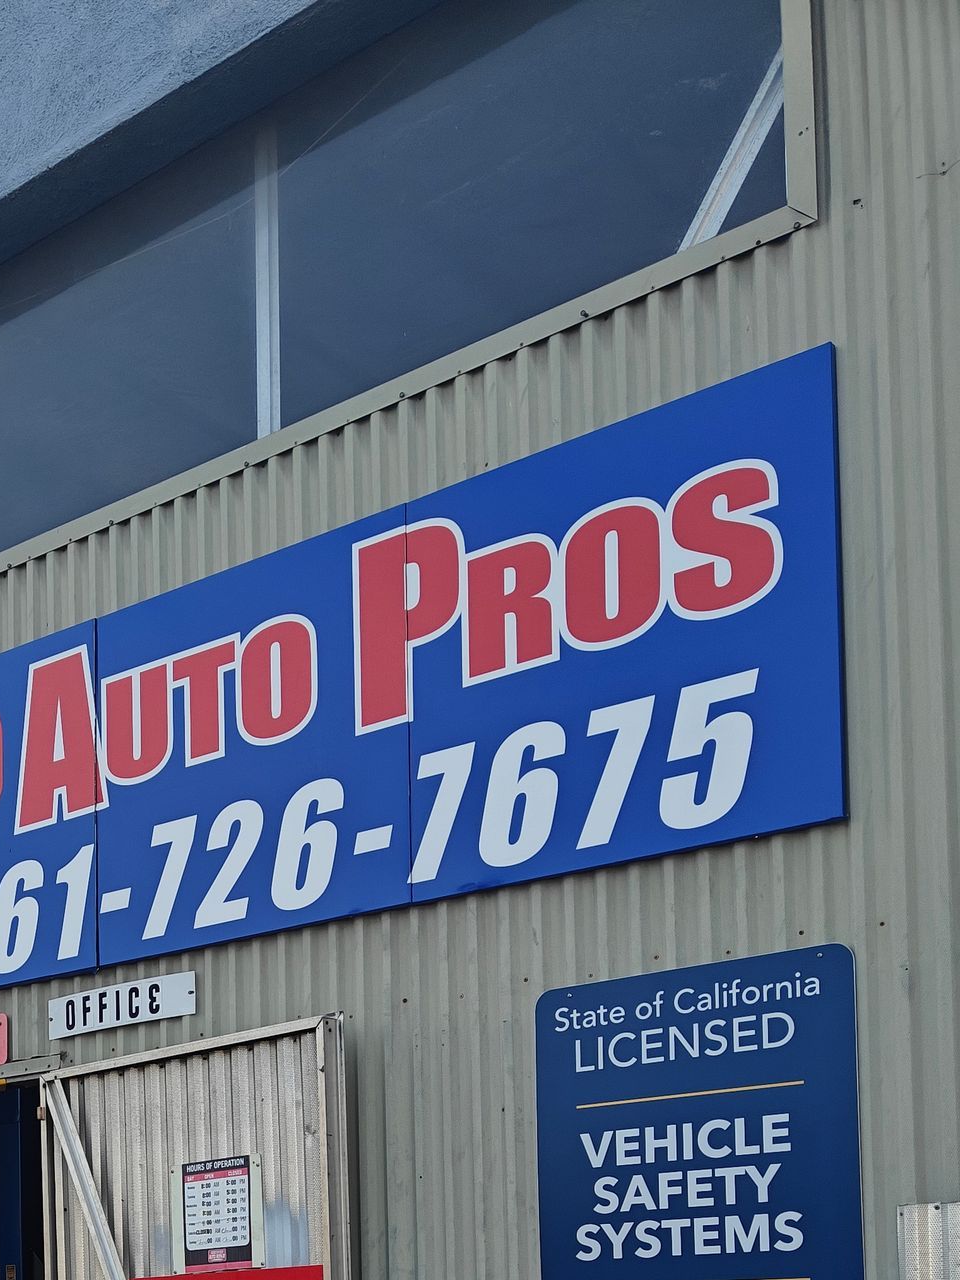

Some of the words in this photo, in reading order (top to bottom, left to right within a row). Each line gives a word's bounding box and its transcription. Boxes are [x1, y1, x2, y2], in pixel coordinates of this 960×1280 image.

[14, 613, 318, 836] AUTO
[352, 458, 784, 737] PROS
[66, 983, 160, 1031] OFFICE
[554, 1005, 626, 1033] State
[635, 990, 665, 1020] of
[673, 972, 821, 1015] California
[575, 1011, 795, 1073] LICENSED
[186, 1164, 205, 1173] HOURS
[206, 1161, 213, 1170] OF
[214, 1157, 245, 1169] OPERATION
[580, 1113, 792, 1168] VEHICLE
[593, 1163, 782, 1215] SAFETY
[575, 1211, 804, 1261] SYSTEMS
